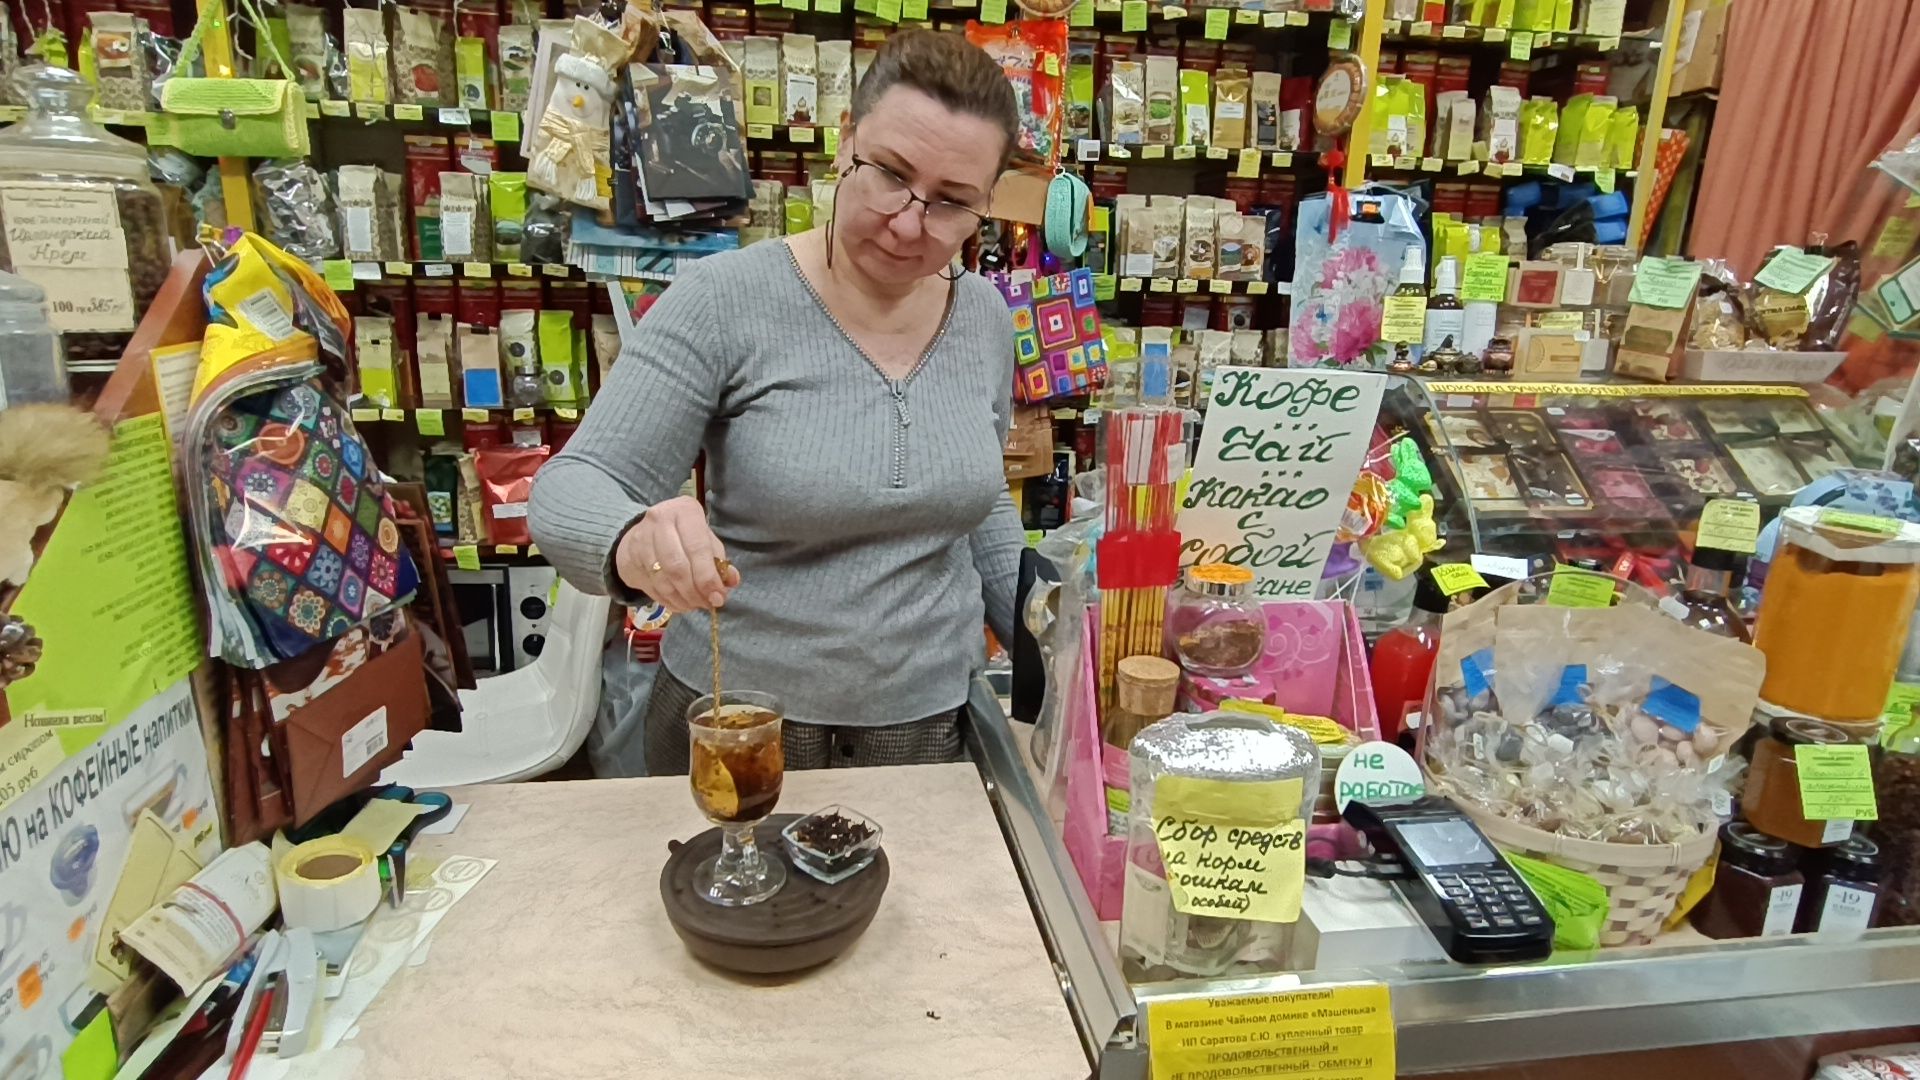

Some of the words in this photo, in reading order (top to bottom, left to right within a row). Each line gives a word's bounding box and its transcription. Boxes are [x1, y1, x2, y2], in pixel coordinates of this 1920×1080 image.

[52, 301, 74, 313] 100
[1215, 371, 1360, 417] Кофе
[1431, 384, 1504, 393] ШОКОЛАД
[1507, 384, 1562, 394] РУЧНОЙ
[1218, 426, 1350, 463] Чай
[1182, 476, 1329, 510] Какао
[73, 709, 107, 725] весны!
[8, 729, 54, 767] сиропом
[18, 766, 39, 793] руб
[24, 807, 49, 849] на
[49, 724, 142, 829] КОФЕЙНЫЕ
[143, 695, 193, 757] напитки
[1156, 815, 1218, 848] Сбор
[1227, 828, 1303, 857] средств
[1196, 851, 1266, 875] корм
[1174, 872, 1268, 894] ошкам
[1208, 995, 1270, 1008] Уважаемые
[1272, 989, 1334, 1005] покупатели!
[1166, 1020, 1173, 1030] В
[1175, 1016, 1224, 1030] магазине
[1226, 1013, 1267, 1026] Чайном
[1269, 1011, 1309, 1024] домике
[1311, 1005, 1377, 1020] «Машенька»
[1181, 1037, 1197, 1048] ИП
[1200, 1033, 1248, 1046] Саратова
[1275, 1026, 1332, 1041] купленный
[1335, 1024, 1364, 1037] товар
[1207, 1042, 1330, 1063] ПРОДОВОЛЬСТВЕННЫЙ
[1188, 1059, 1310, 1080] ПРОДОВОЛЬСТВЕННЫЙ
[1318, 1058, 1362, 1070] ОБМЕНУ
[1365, 1057, 1373, 1067] И
